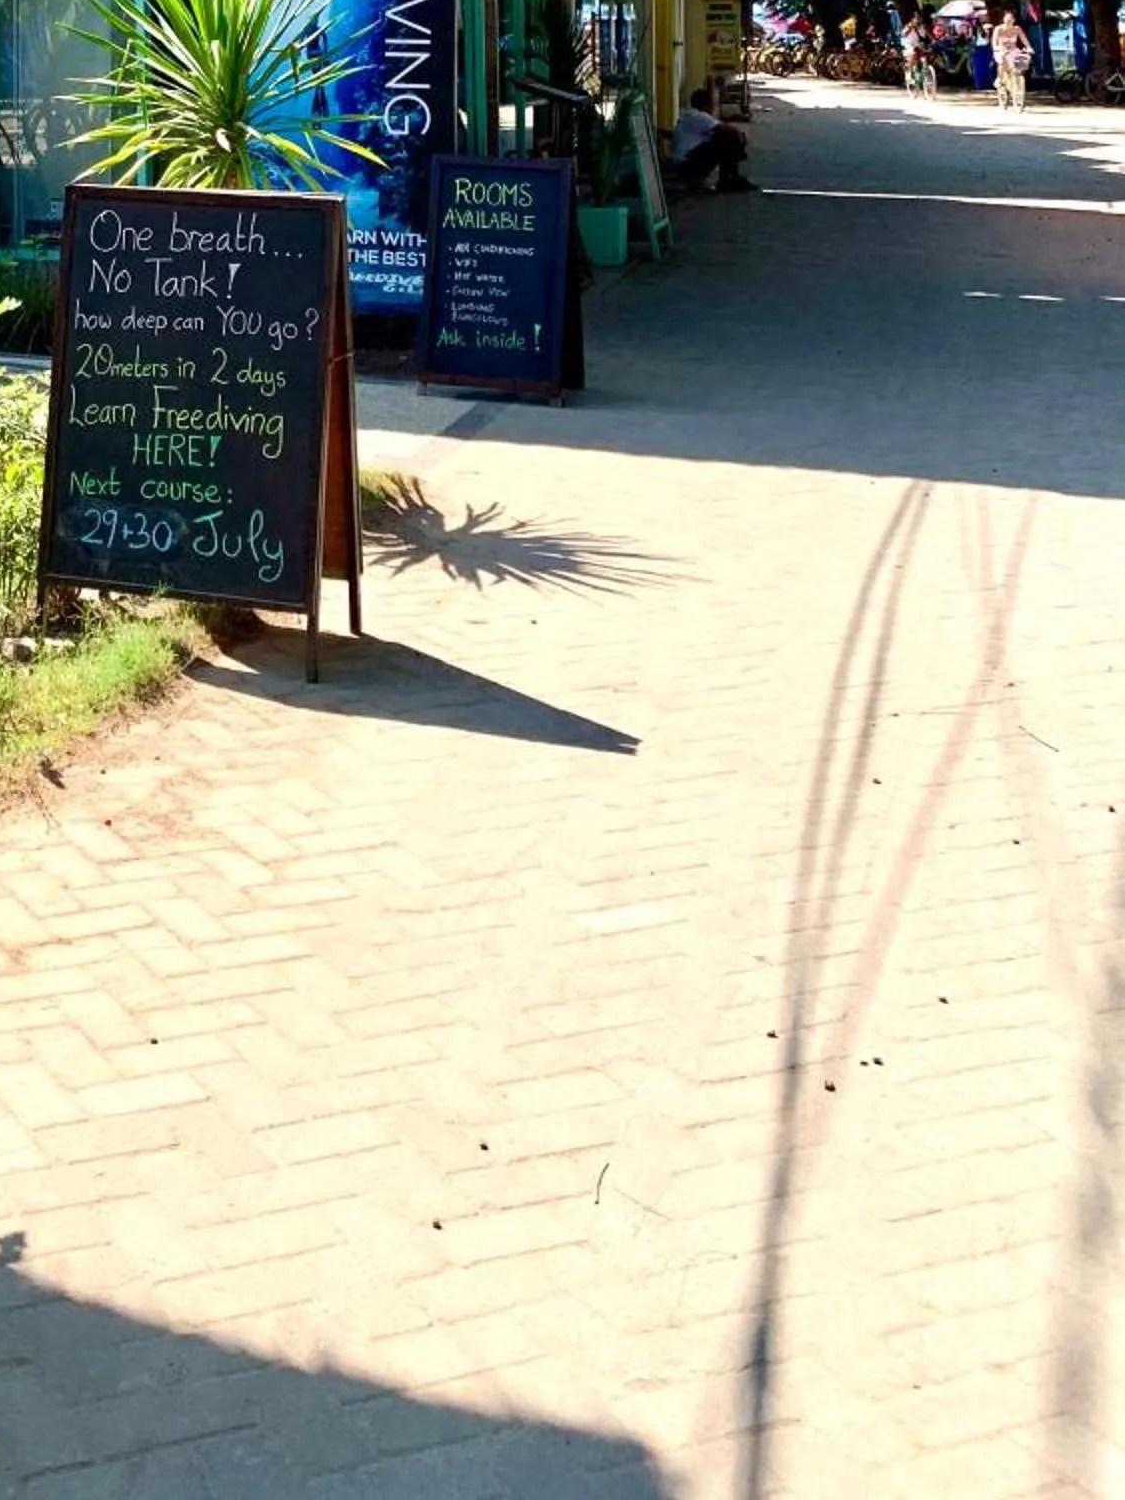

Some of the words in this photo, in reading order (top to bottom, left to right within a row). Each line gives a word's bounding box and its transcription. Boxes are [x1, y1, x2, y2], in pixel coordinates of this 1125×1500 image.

[455, 177, 534, 207] ROOMS
[89, 209, 154, 252] One
[442, 207, 535, 231] AVAILABLE
[88, 258, 132, 293] No
[347, 248, 379, 264] THE
[382, 250, 426, 268] BEST
[74, 299, 112, 330] how
[121, 305, 167, 336] deep
[172, 315, 204, 331] can
[216, 304, 262, 336] YOU
[176, 356, 196, 379] in
[210, 347, 230, 385] 2
[236, 357, 286, 397] days
[68, 383, 136, 427] Learn
[152, 385, 284, 459] Freediving
[132, 433, 223, 468] HERE!
[69, 465, 121, 496] Next
[192, 509, 284, 583] July
